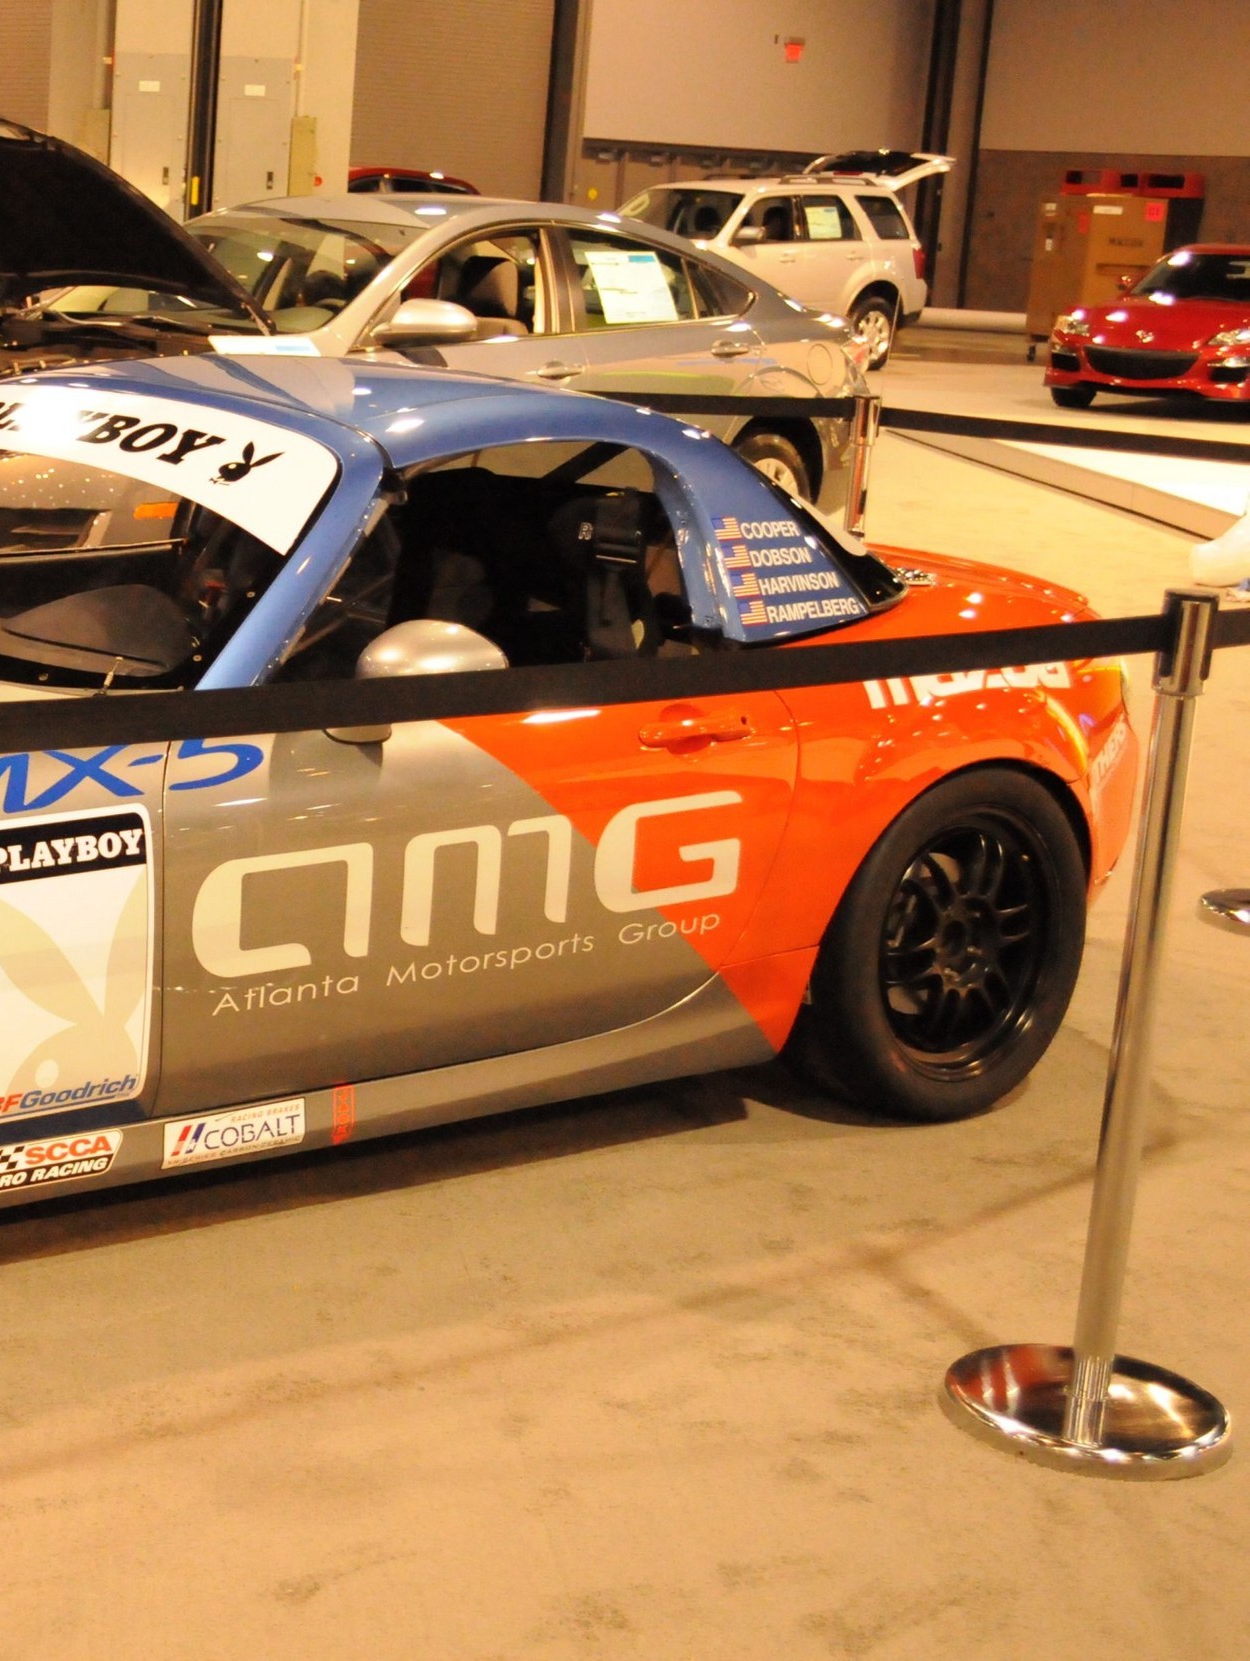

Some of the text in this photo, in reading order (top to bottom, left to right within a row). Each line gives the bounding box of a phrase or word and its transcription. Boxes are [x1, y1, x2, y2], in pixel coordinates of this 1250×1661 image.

[740, 520, 800, 540] COOPER
[749, 546, 812, 568] DOBSON
[758, 571, 840, 596] HARVINSON
[766, 597, 861, 624] RAMPELBERG
[211, 912, 721, 1017] Atlanta Motorsports Group
[204, 1113, 301, 1150] COBALT
[25, 1136, 112, 1165] SCCA
[30, 1157, 109, 1182] RACING
